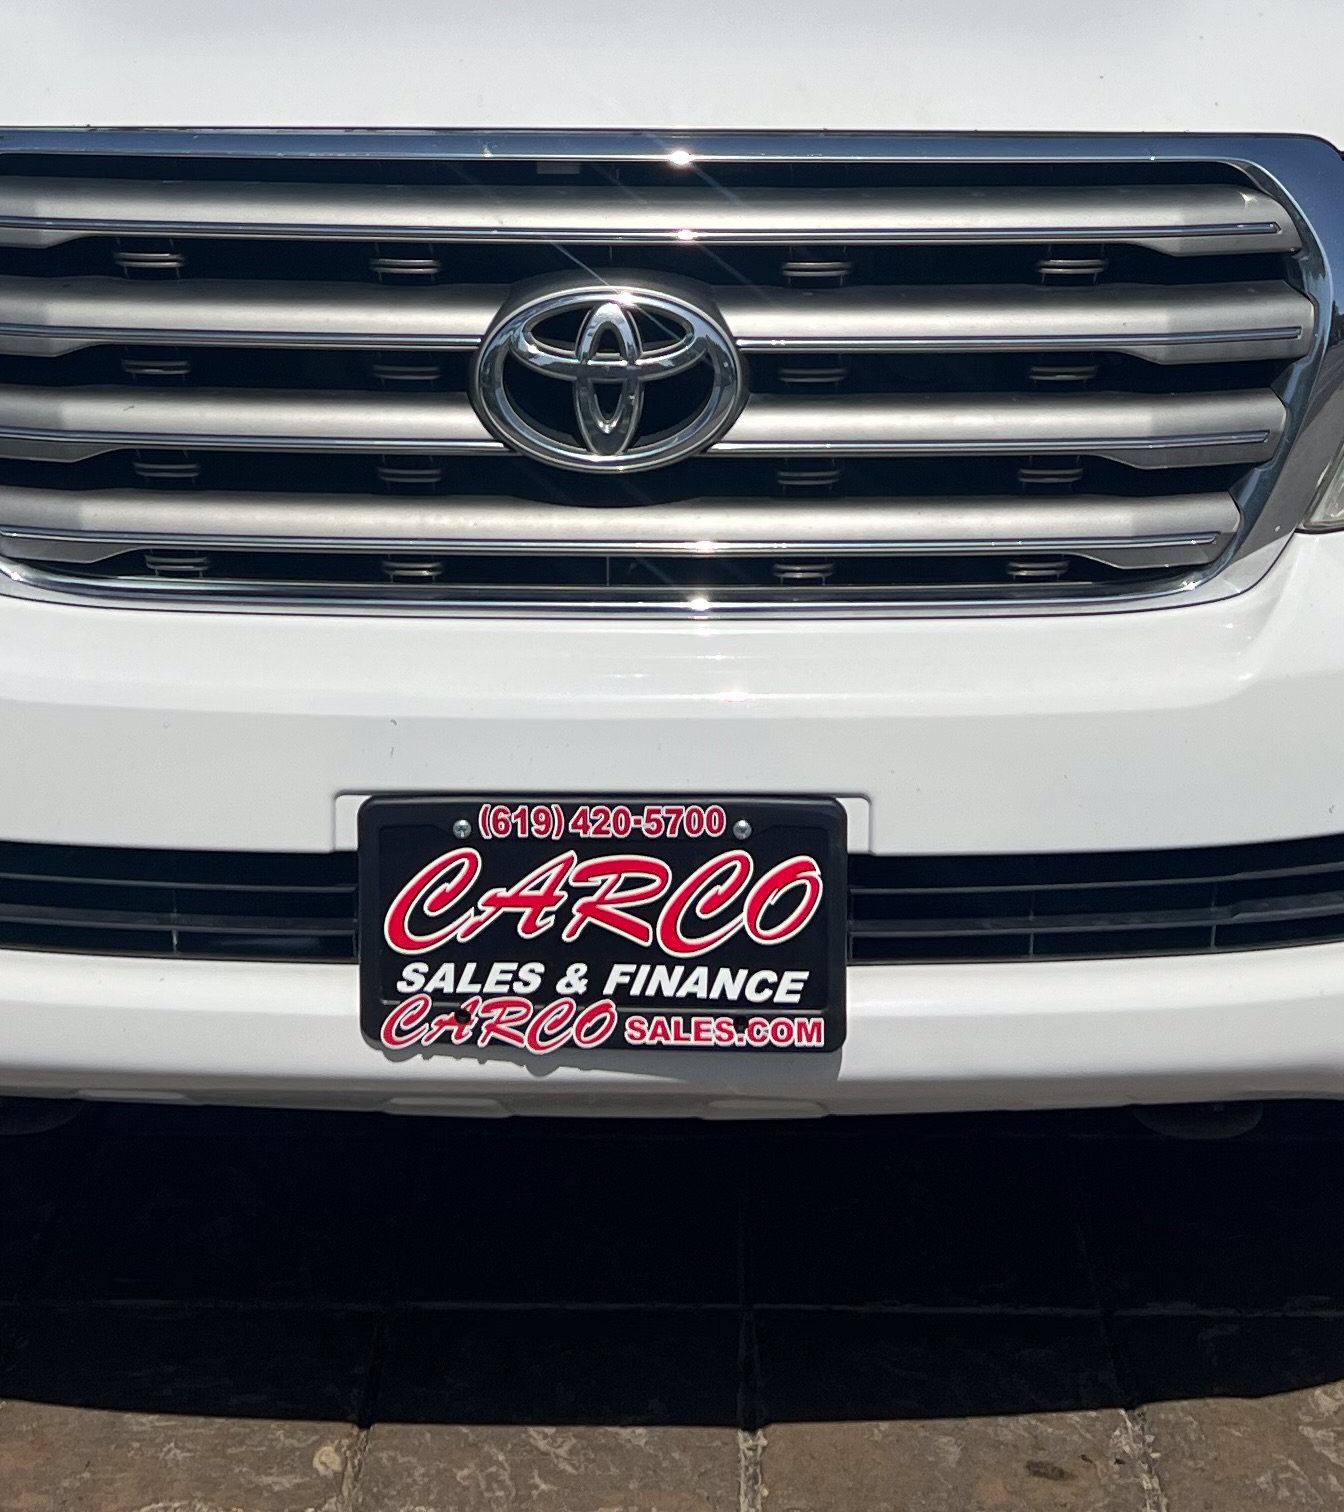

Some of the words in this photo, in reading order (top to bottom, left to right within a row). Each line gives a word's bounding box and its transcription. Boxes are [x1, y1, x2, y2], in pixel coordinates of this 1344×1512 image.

[479, 803, 564, 841] (619)
[569, 804, 726, 840] 420-5700
[383, 846, 824, 958] CARCO
[396, 962, 545, 995] SALES
[556, 962, 590, 996] &
[602, 964, 810, 1005] FINANCE
[380, 995, 618, 1055] CARCO
[624, 1015, 824, 1048] SALES.COM
